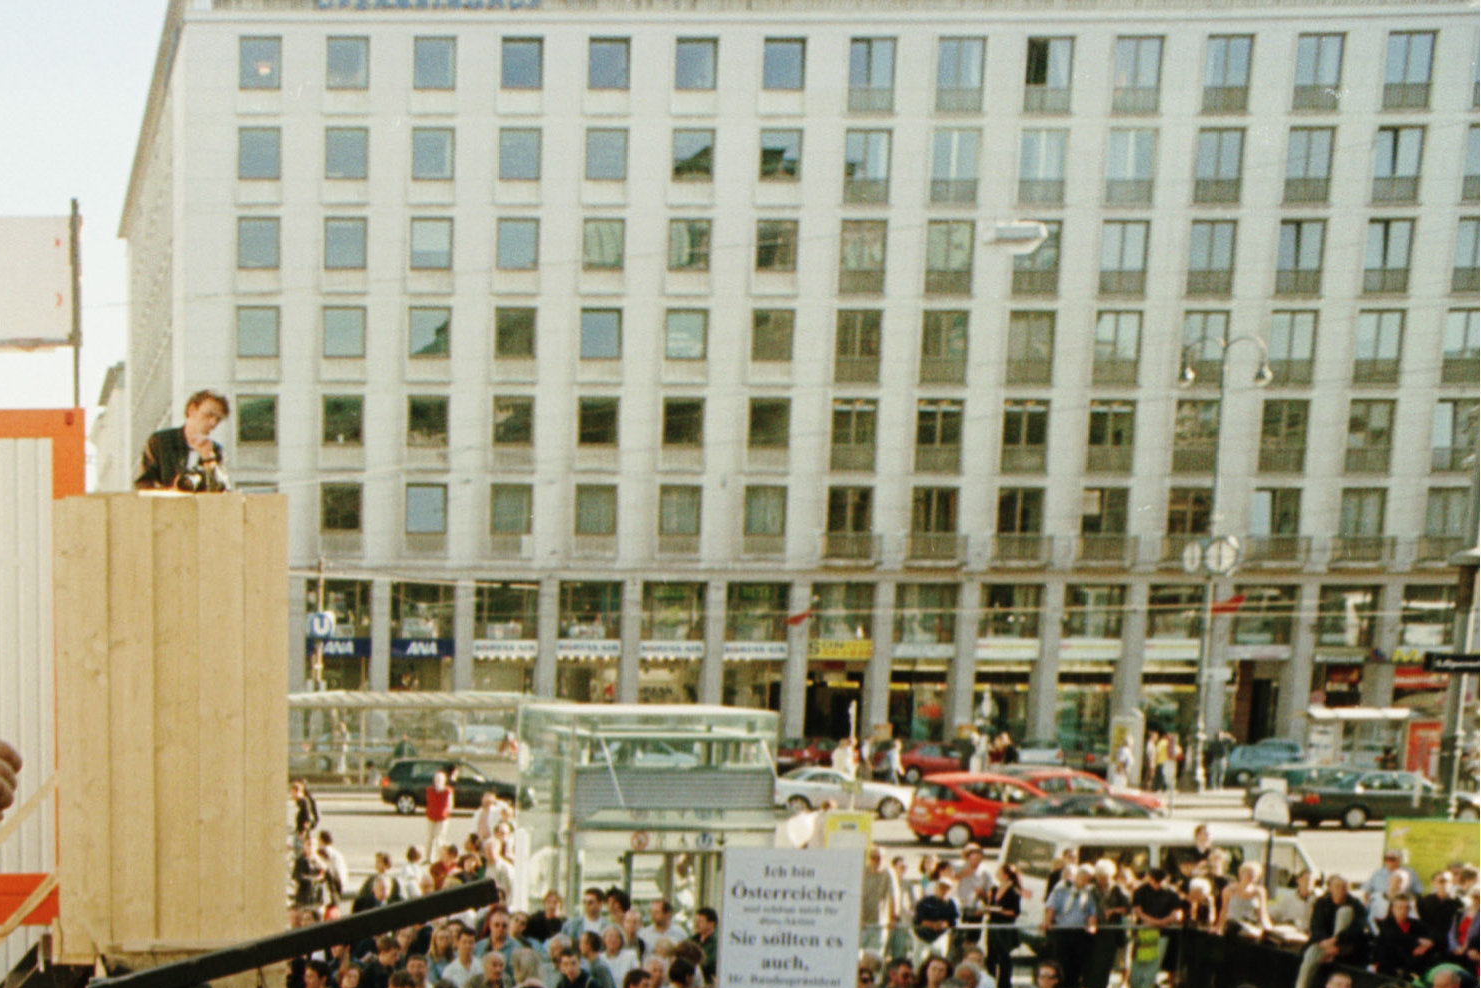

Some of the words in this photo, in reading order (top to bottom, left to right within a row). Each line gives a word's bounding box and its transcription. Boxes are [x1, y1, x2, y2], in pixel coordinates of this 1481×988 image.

[312, 614, 332, 636] U
[324, 640, 354, 655] ANA
[406, 640, 438, 655] ANA
[764, 865, 787, 879] Ich
[791, 866, 816, 879] bin
[730, 880, 847, 902] Österreicher
[729, 930, 757, 946] Sie
[762, 930, 820, 948] sollten
[825, 936, 844, 949] es
[760, 955, 810, 973] auch,
